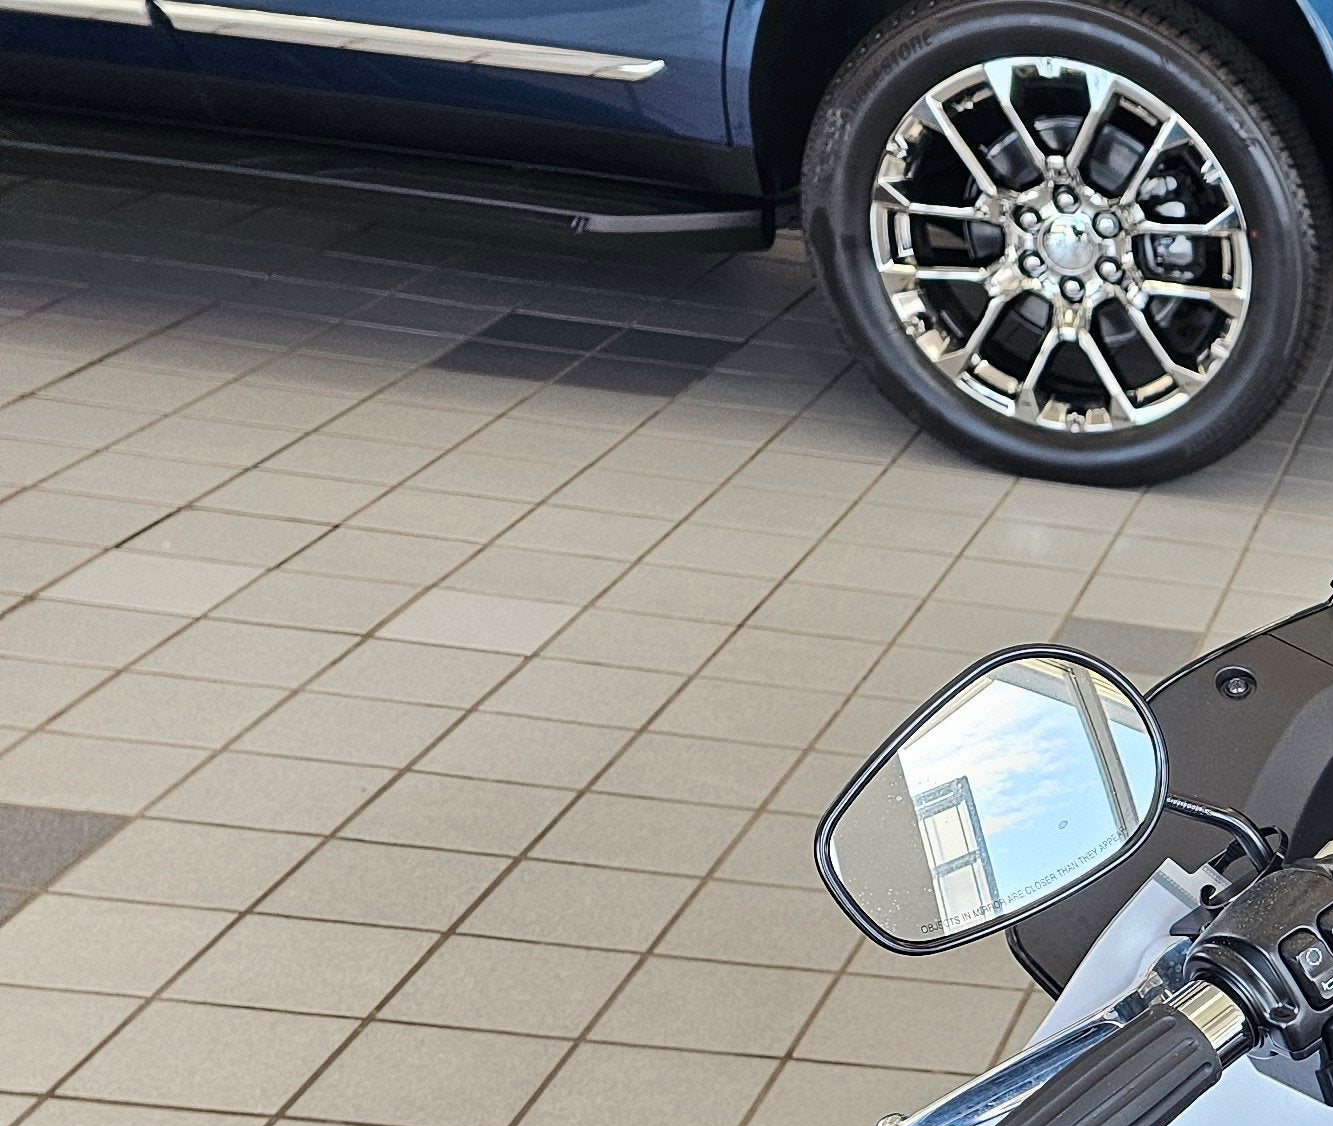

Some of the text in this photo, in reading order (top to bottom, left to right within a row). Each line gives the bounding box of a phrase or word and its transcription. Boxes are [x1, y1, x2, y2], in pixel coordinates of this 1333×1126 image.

[921, 915, 961, 934] OBJECTS
[961, 910, 972, 921] IN
[973, 897, 1006, 917] MIRROR
[1007, 889, 1025, 904] ARE
[1025, 873, 1058, 896] CLOSER
[1057, 861, 1080, 881] THAN
[1078, 847, 1099, 869] THEY
